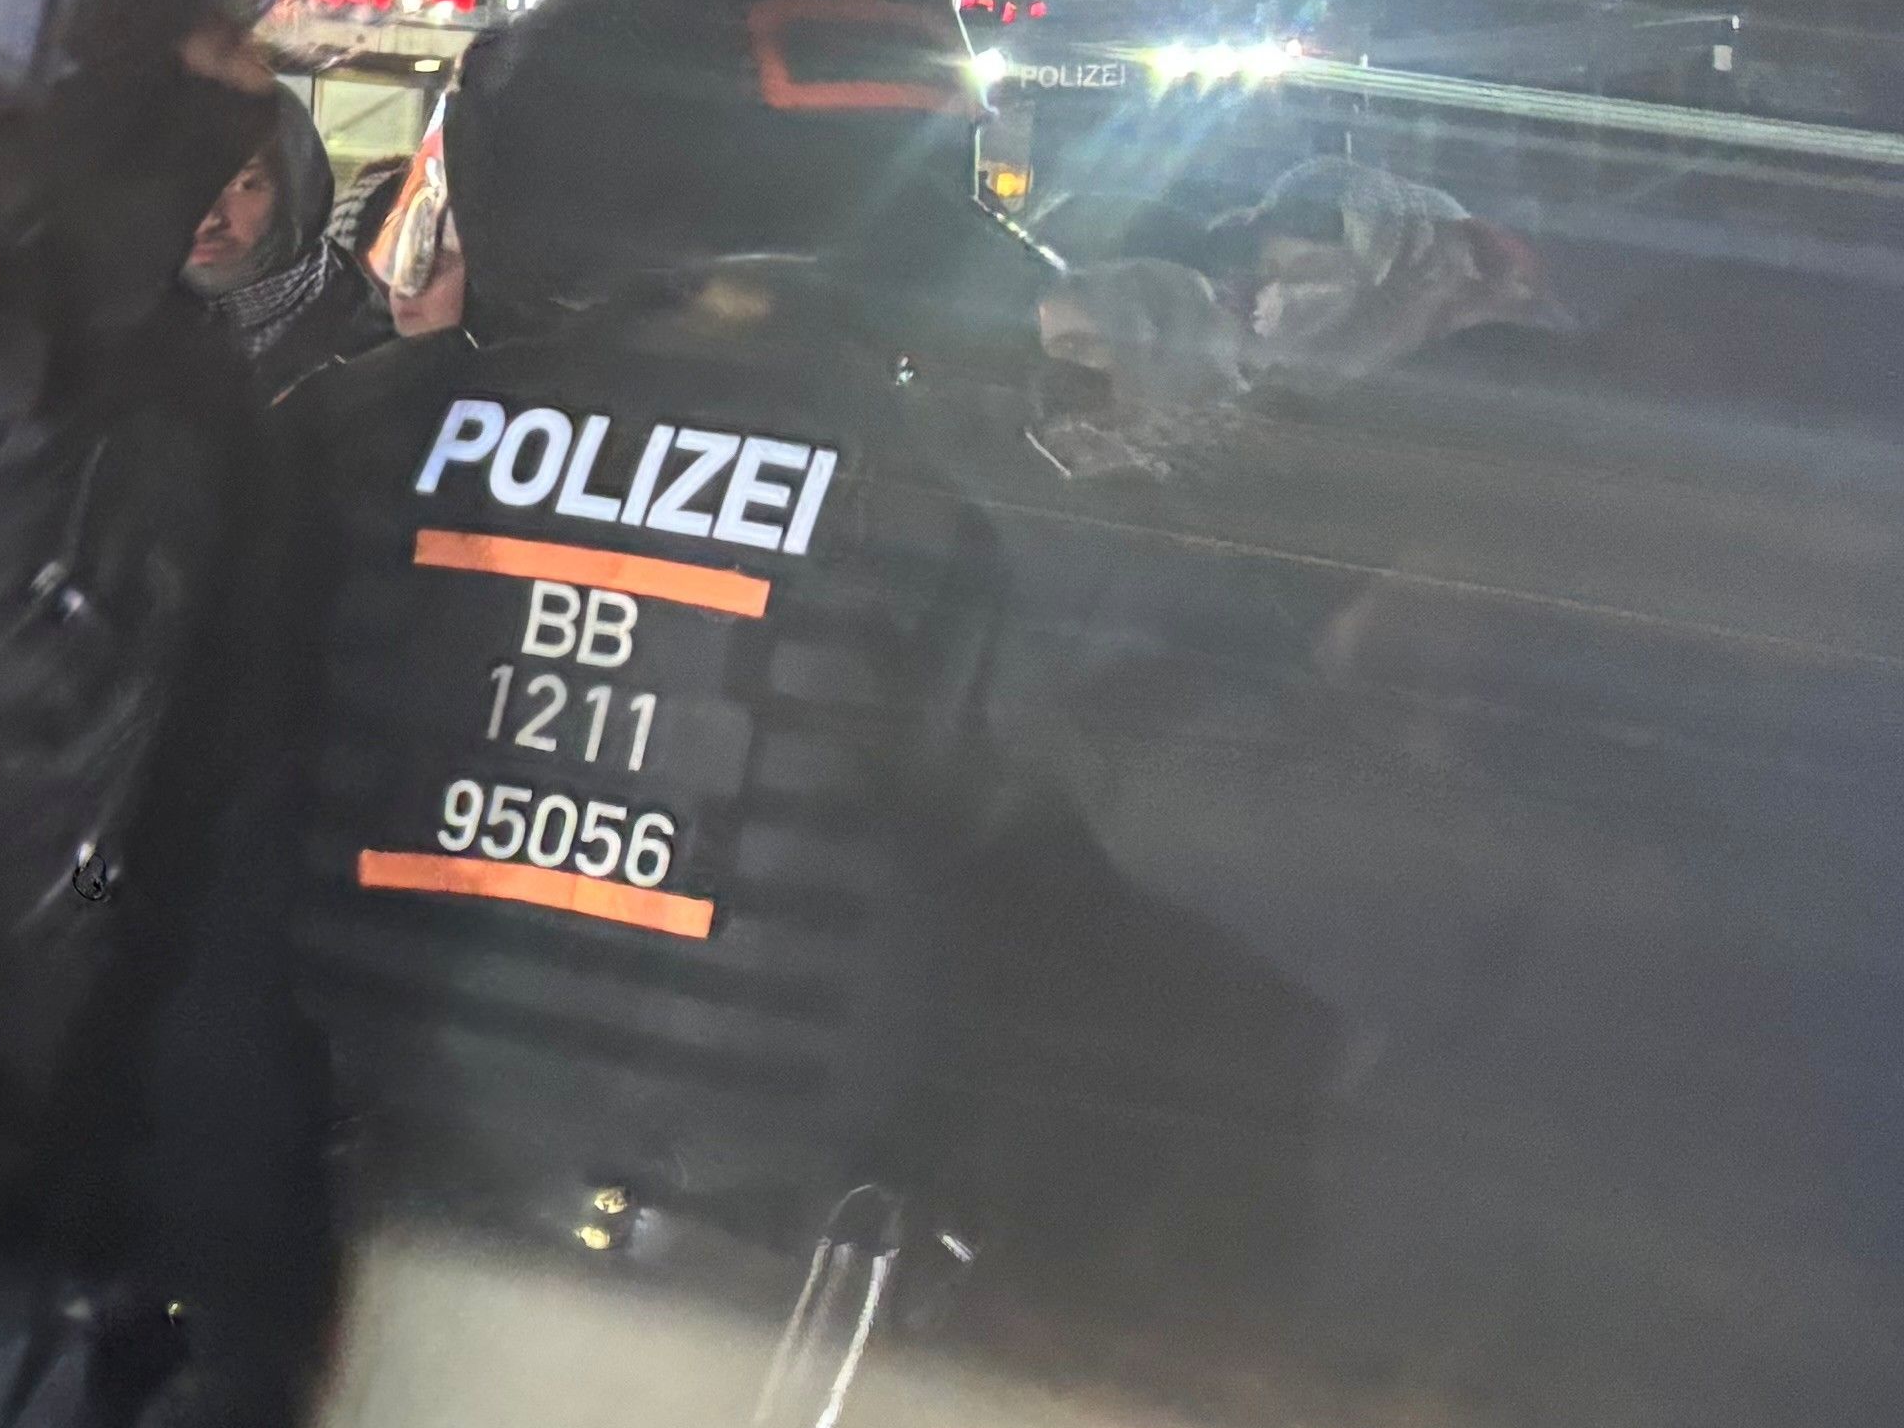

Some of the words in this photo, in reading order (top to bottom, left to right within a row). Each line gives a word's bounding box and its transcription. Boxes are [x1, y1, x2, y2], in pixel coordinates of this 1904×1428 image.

[1019, 61, 1127, 88] POLIZEI
[415, 398, 838, 556] POLIZEI
[520, 578, 640, 669] BB
[485, 663, 658, 772] 1211
[436, 779, 677, 887] 95056
